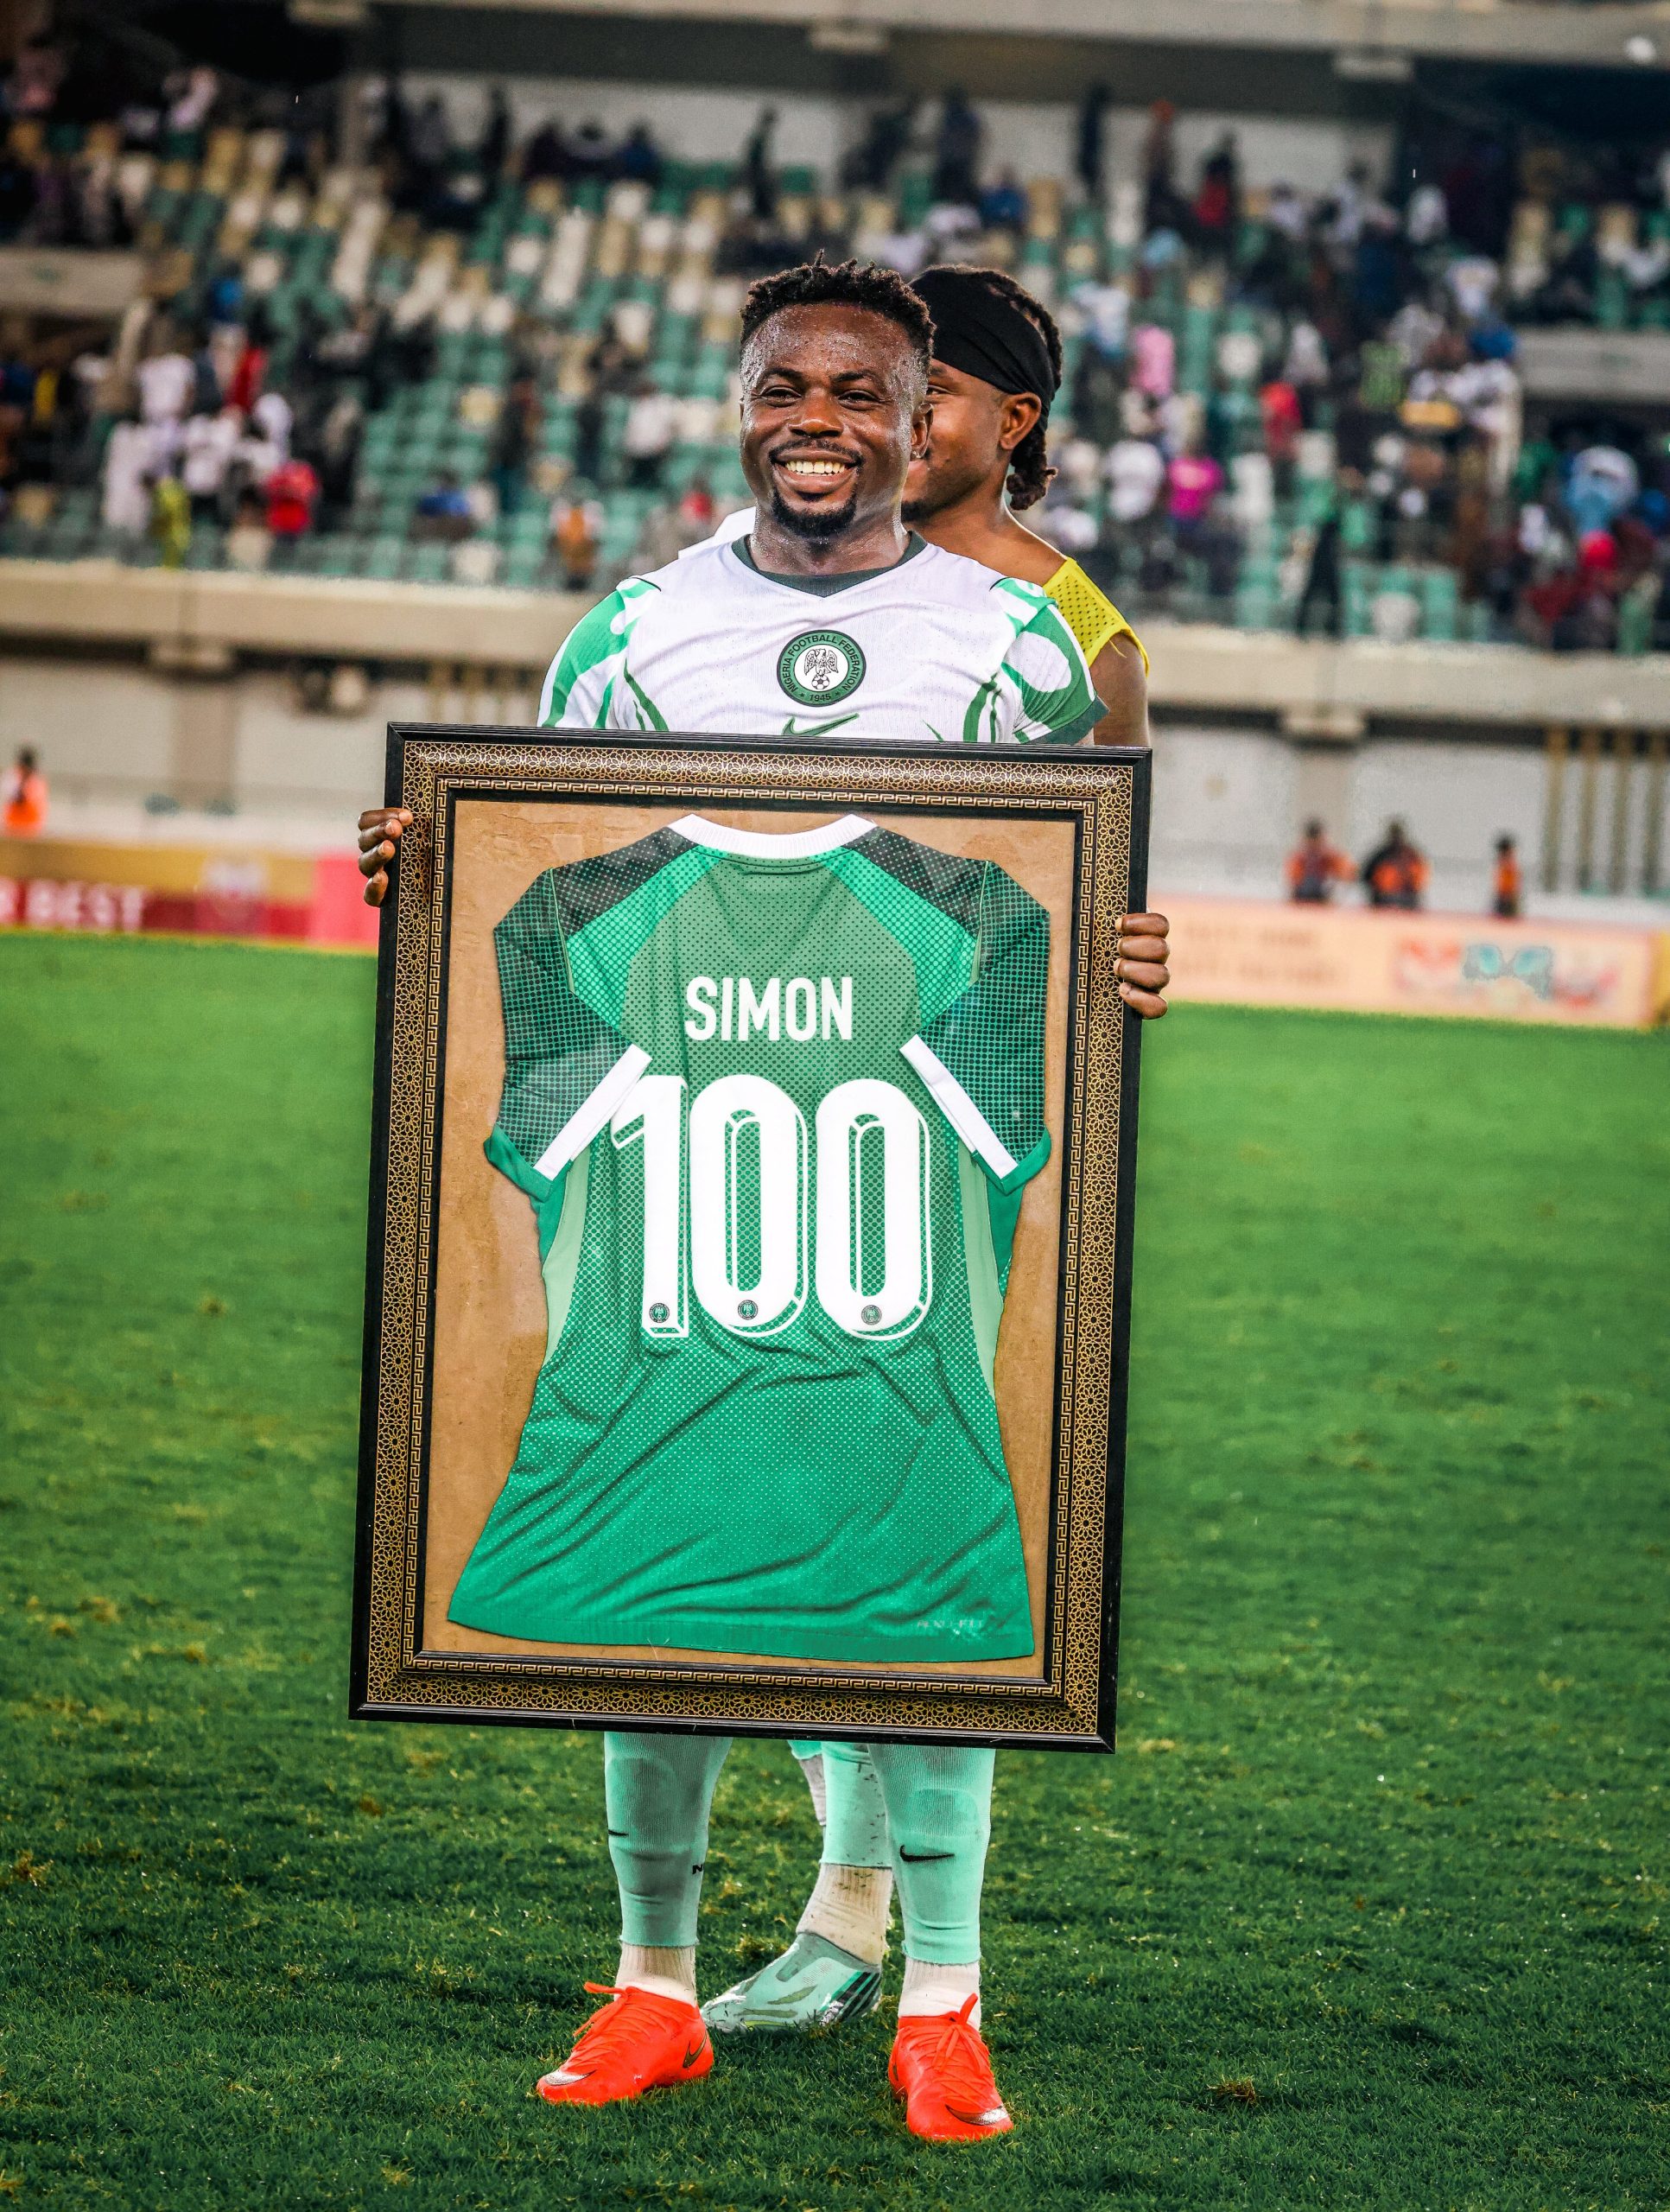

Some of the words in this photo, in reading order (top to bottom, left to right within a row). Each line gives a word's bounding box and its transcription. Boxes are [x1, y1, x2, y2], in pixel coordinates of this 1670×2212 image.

[788, 635, 837, 657] FOOTBALL
[838, 639, 860, 690] FEDERATION
[782, 658, 797, 692] NIGERIA
[685, 976, 853, 1040] SIMON
[611, 1074, 933, 1340] 100
